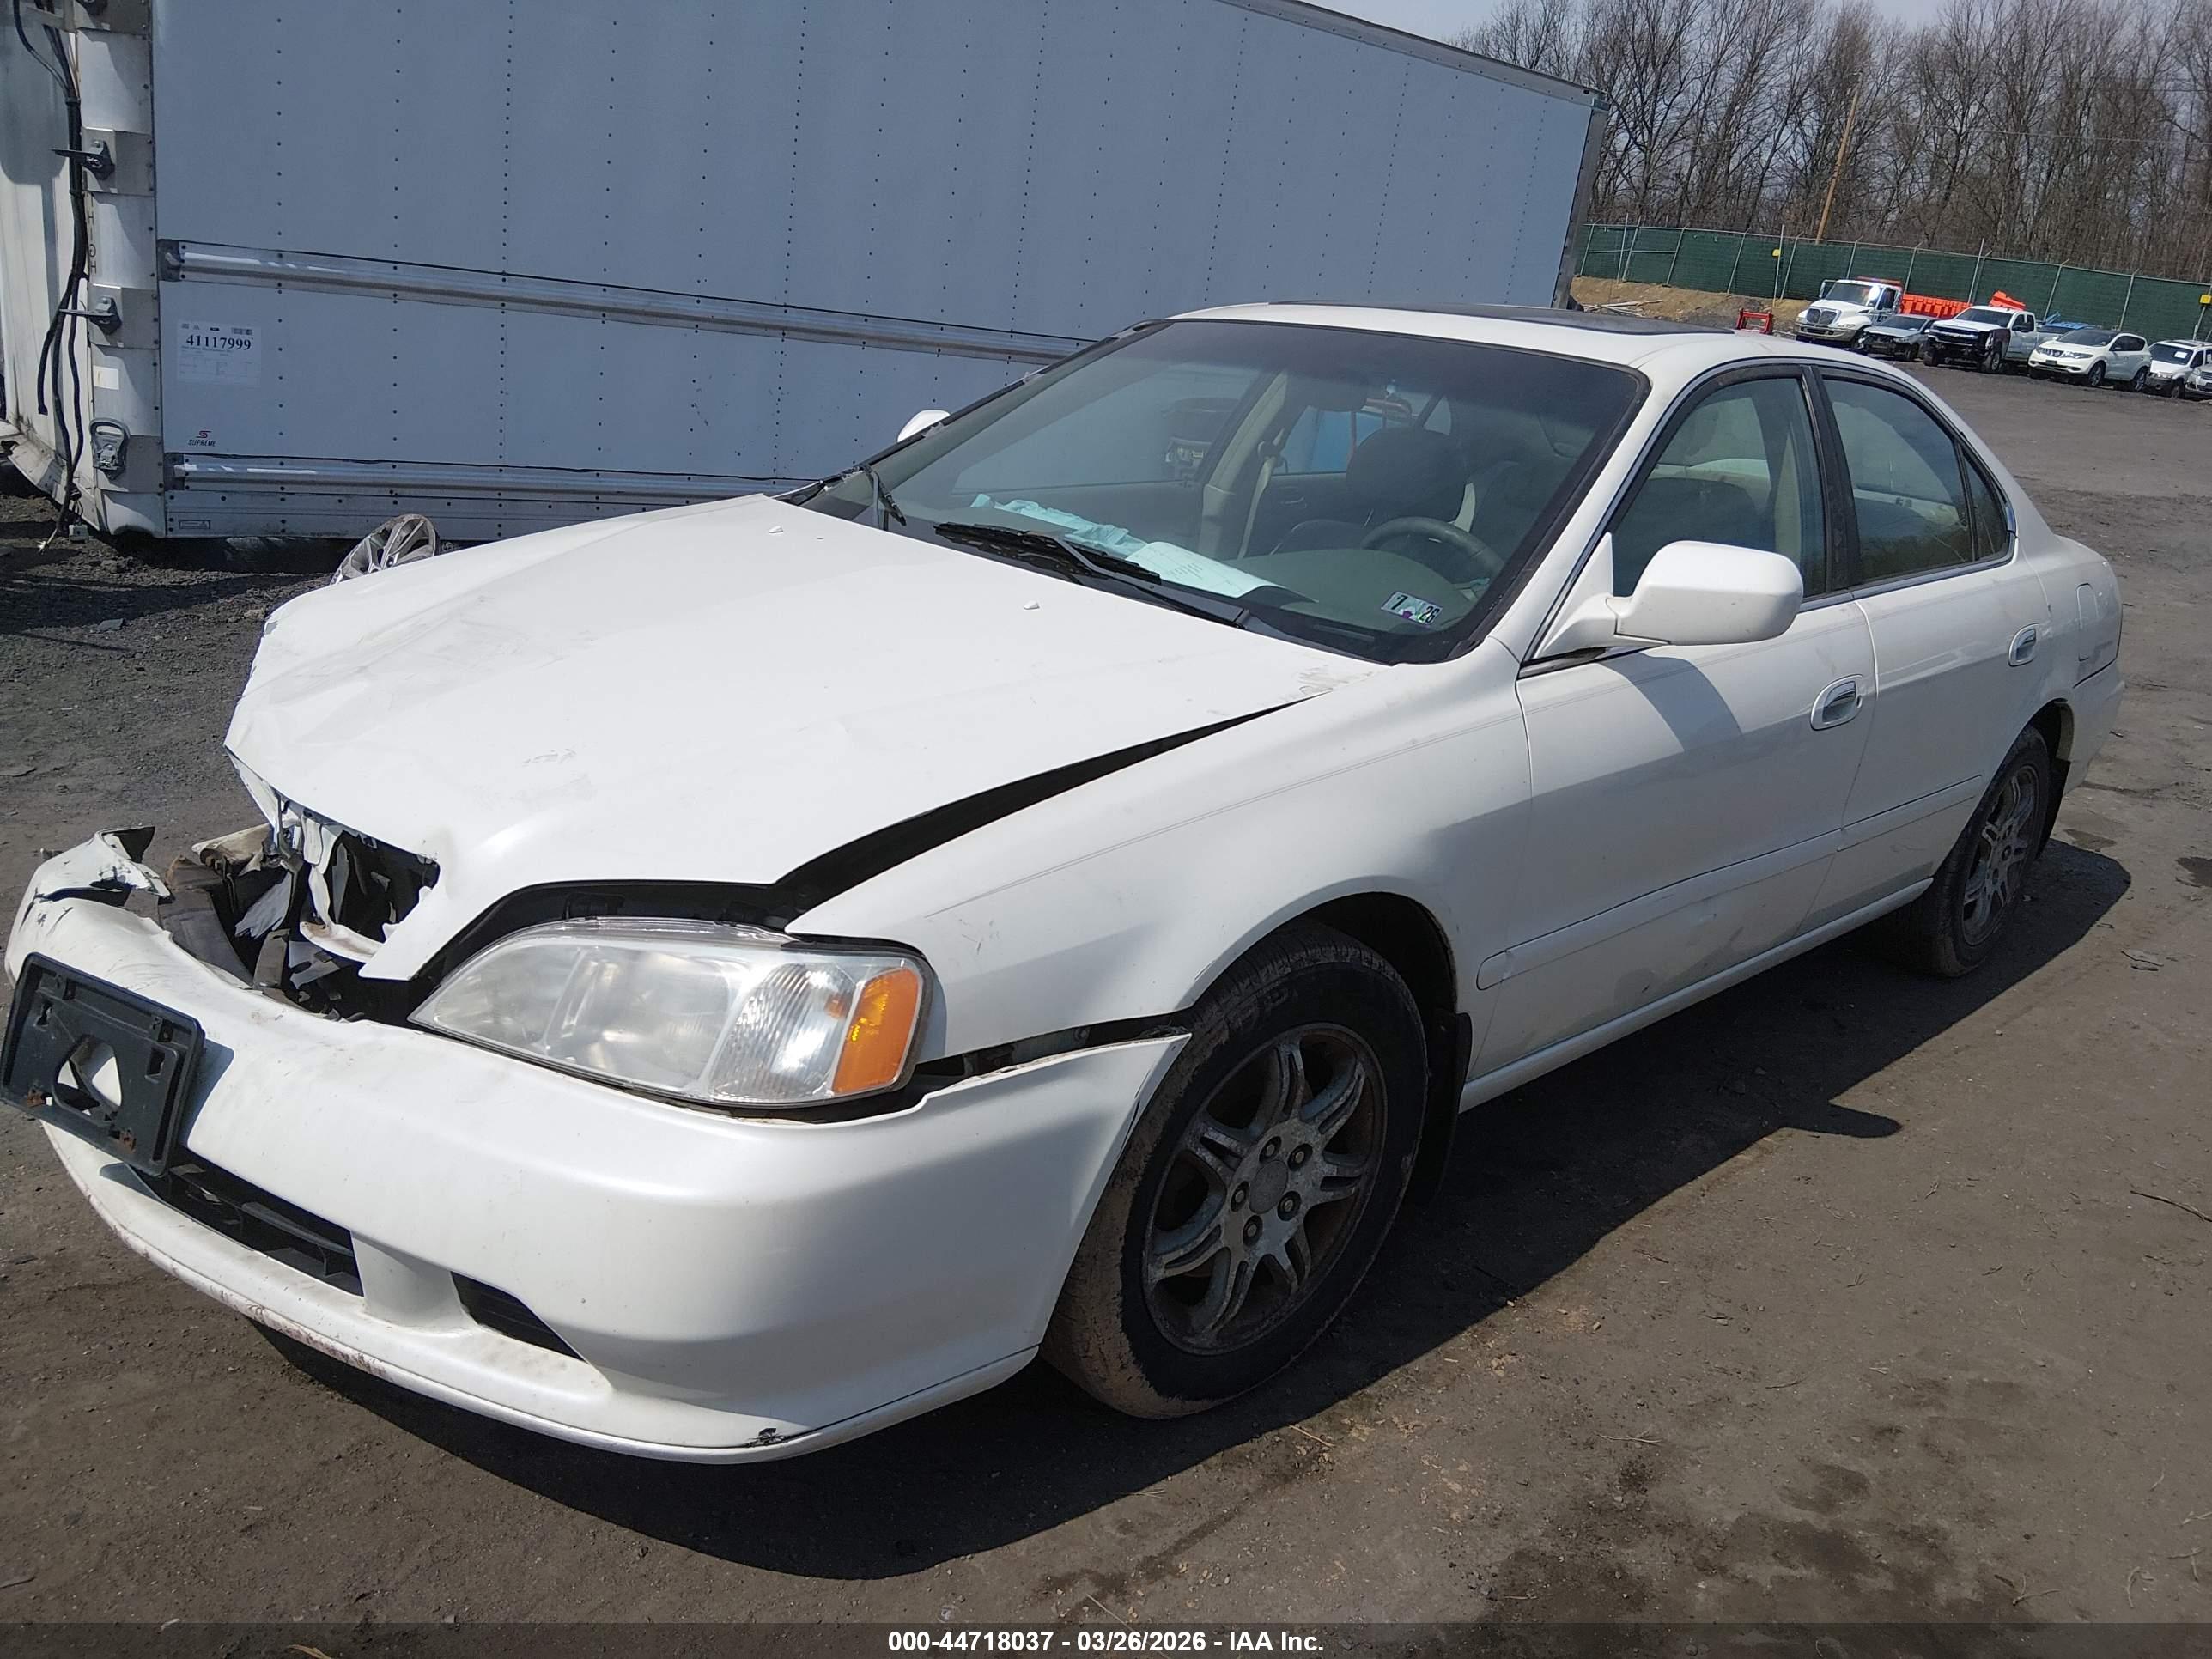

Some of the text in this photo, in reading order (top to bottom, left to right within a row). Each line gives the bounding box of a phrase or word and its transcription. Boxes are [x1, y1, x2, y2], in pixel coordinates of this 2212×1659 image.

[185, 334, 252, 351] 41117999
[1391, 594, 1440, 623] 7 26
